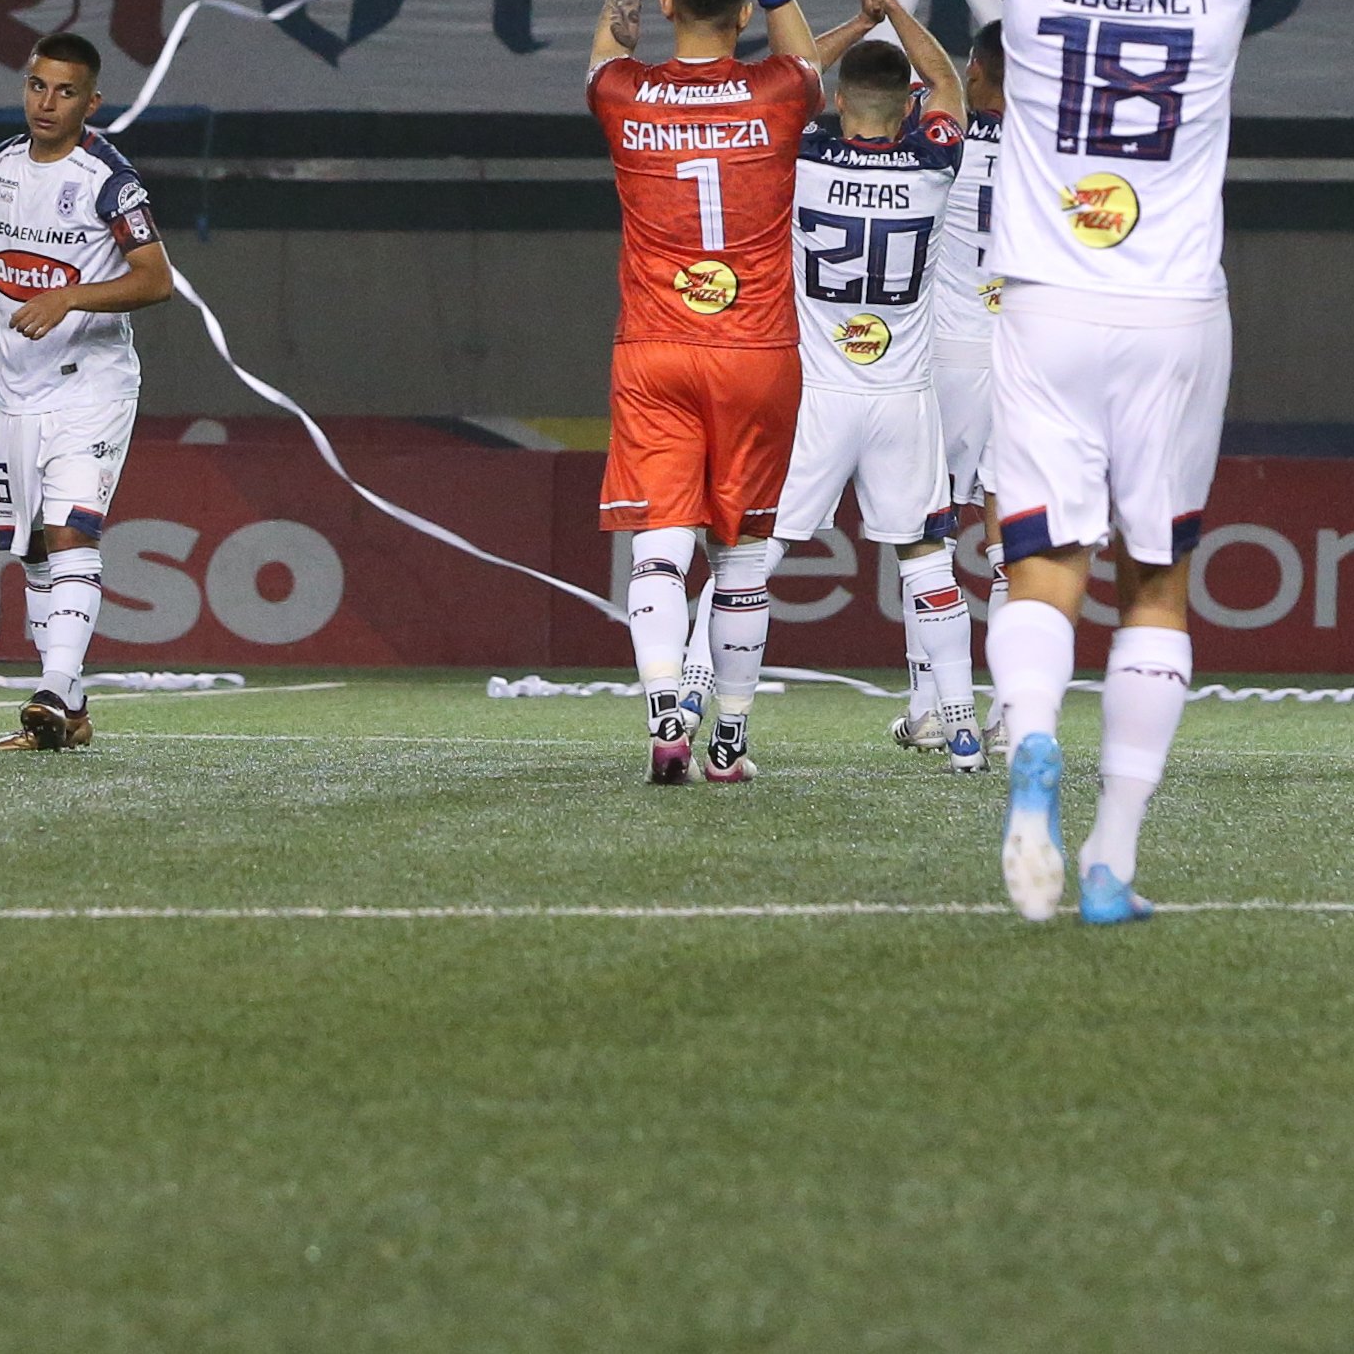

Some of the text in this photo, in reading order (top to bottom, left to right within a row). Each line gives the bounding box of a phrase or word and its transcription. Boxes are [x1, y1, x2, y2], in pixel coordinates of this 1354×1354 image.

[622, 119, 769, 150] SANHUEZA
[1038, 16, 1194, 161] 18
[676, 157, 726, 252] 1
[827, 180, 910, 209] ARIAS
[798, 206, 935, 306] 20
